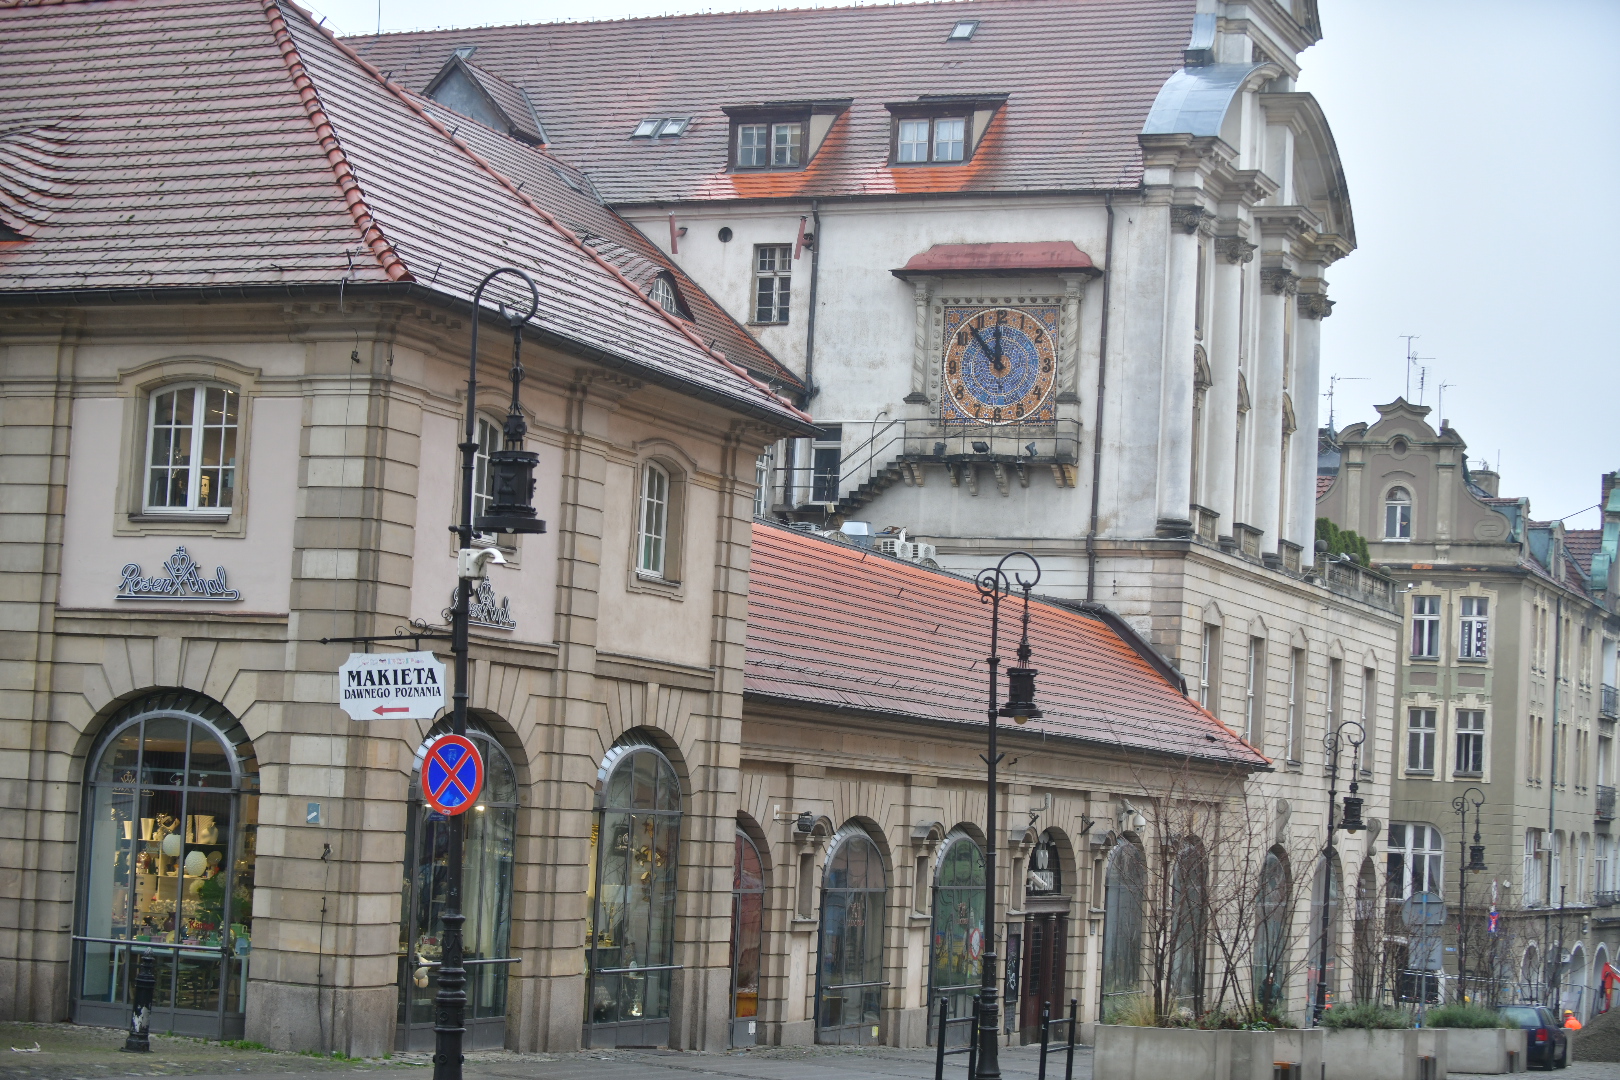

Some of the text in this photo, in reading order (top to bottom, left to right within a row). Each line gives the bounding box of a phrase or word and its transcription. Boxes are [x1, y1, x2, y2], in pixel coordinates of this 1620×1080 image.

[977, 315, 985, 329] 11
[996, 310, 1007, 324] 12
[1019, 315, 1025, 329] 1
[957, 331, 968, 345] 10
[1035, 329, 1043, 343] 2
[949, 361, 956, 375] 9
[1042, 358, 1050, 373] 3
[955, 385, 963, 400] 8
[1033, 385, 1041, 400] 4
[974, 404, 981, 417] 7
[994, 407, 1001, 422] 6
[1016, 403, 1024, 417] 5
[115, 561, 240, 600] Rosenthal
[347, 667, 438, 687] MAKIETA
[344, 686, 442, 700] DAWNEGO POZNANIA
